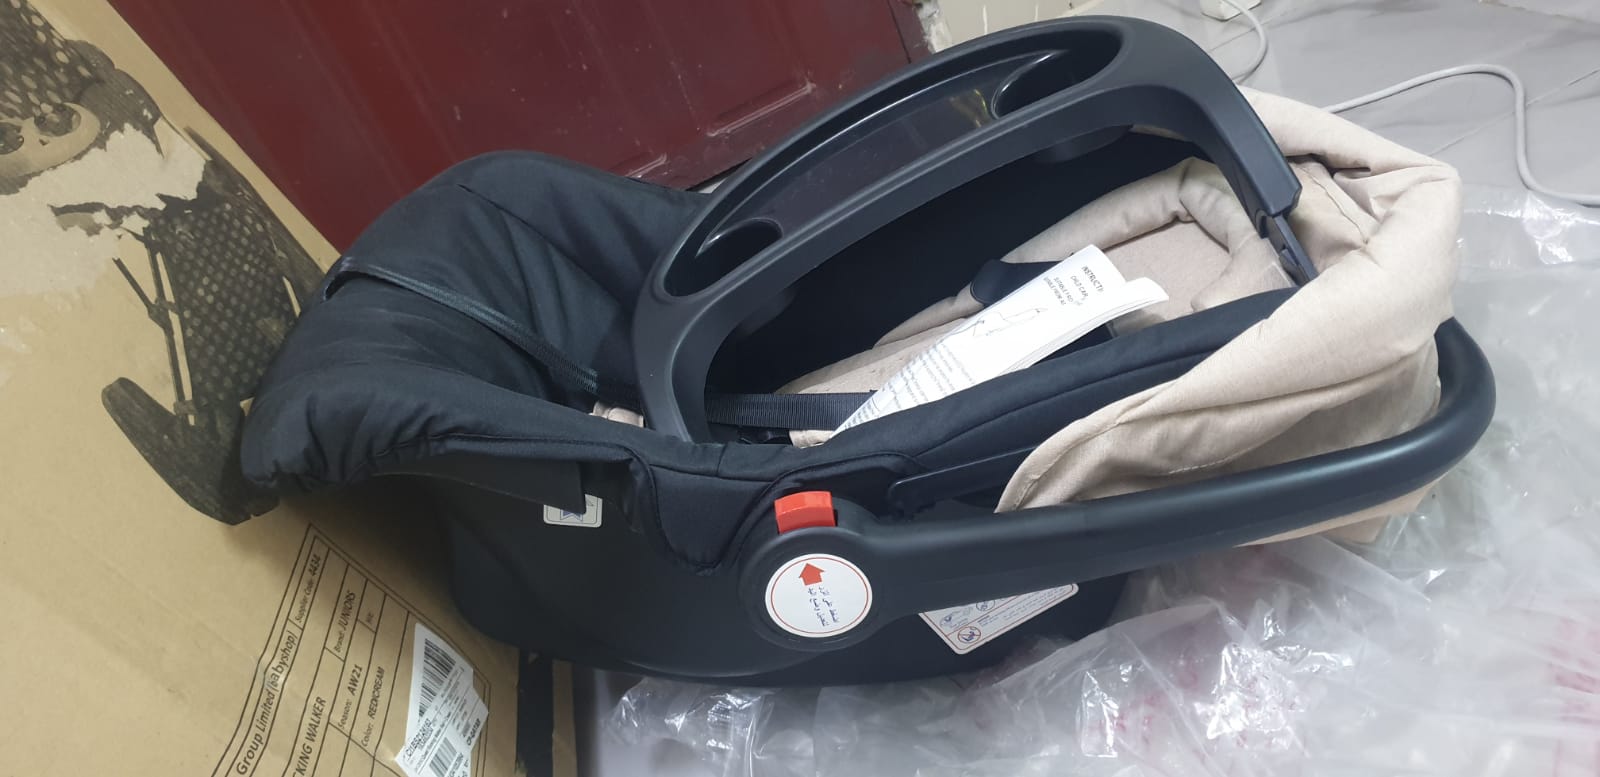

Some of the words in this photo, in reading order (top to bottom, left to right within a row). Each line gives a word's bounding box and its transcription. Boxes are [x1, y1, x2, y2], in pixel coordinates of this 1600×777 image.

[295, 595, 309, 623] Supplier
[338, 591, 356, 631] JUNIORS
[236, 732, 263, 775] Group
[255, 686, 277, 732] Limited
[267, 630, 297, 692] (babyshop)
[338, 701, 352, 729] Season:
[348, 664, 363, 696] AW21
[306, 697, 326, 742] WALKER
[361, 720, 374, 747] Color:
